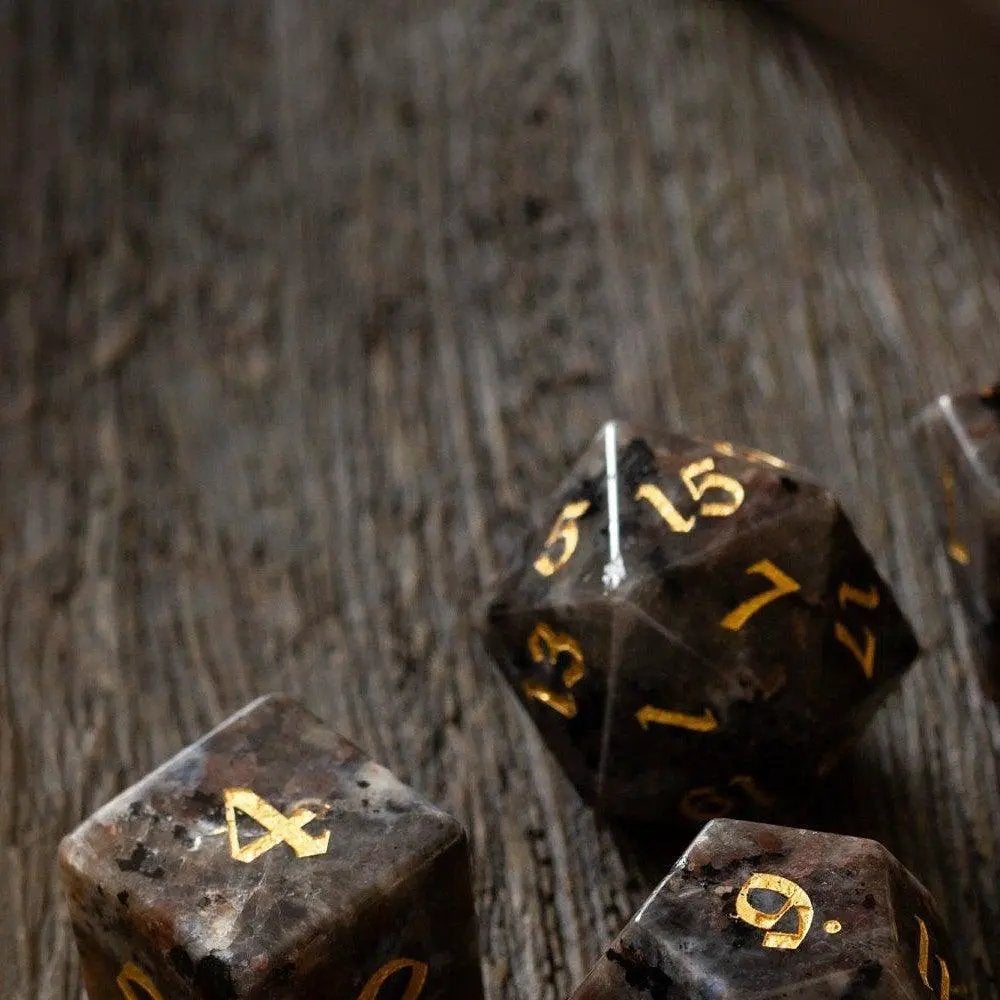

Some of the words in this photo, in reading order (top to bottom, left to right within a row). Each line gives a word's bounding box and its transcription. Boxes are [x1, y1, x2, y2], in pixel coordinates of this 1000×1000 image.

[634, 456, 745, 533] 15
[533, 498, 590, 577] 5
[719, 558, 800, 632] 7
[833, 581, 880, 680] 17
[521, 621, 585, 719] 13
[223, 786, 332, 863] 4
